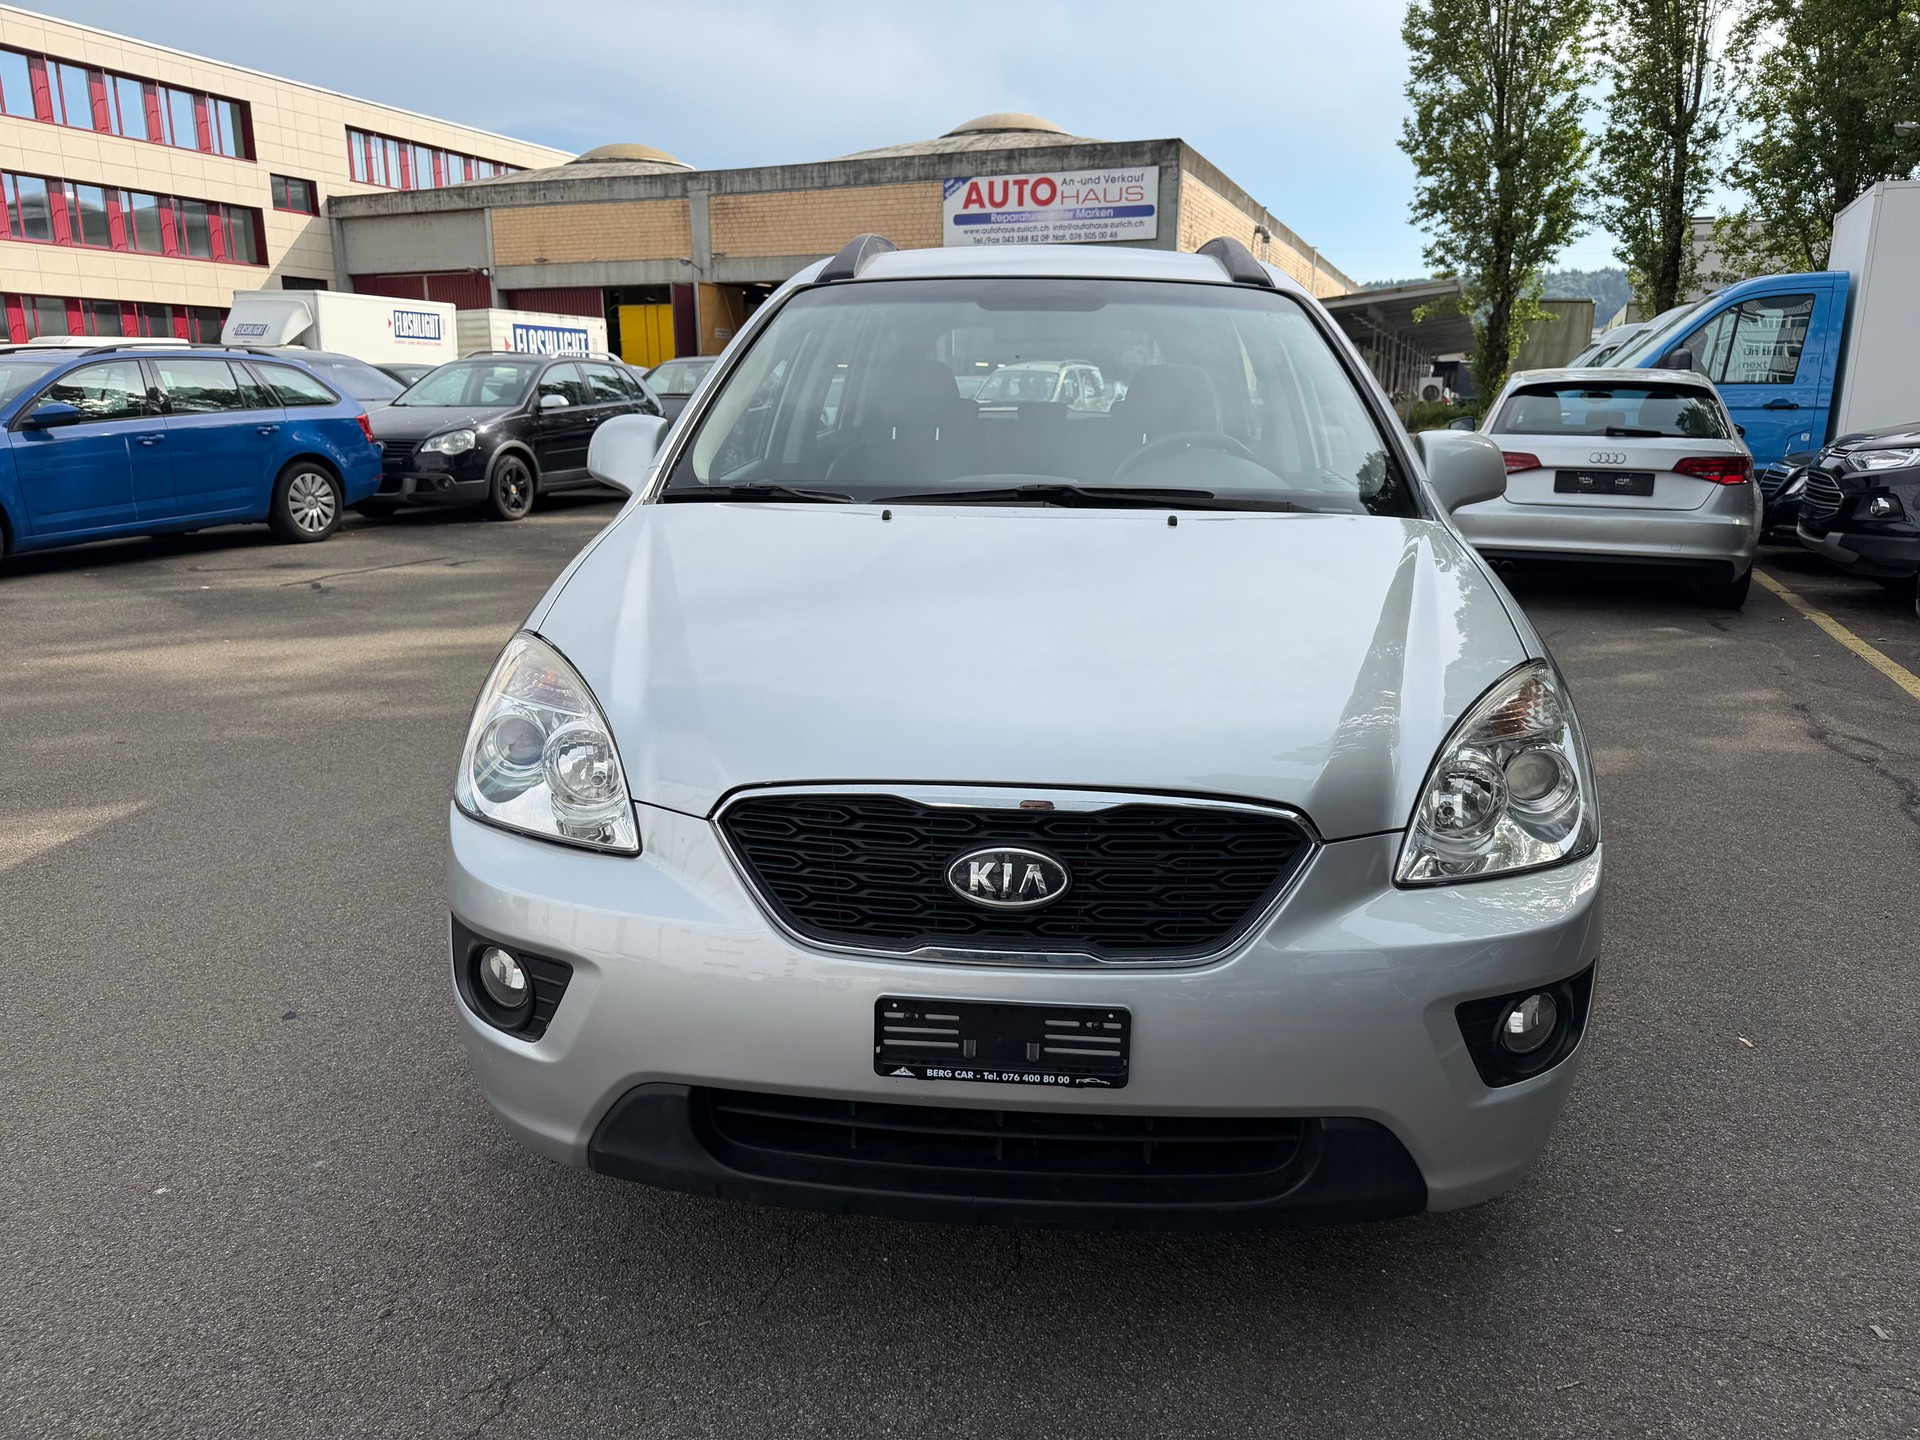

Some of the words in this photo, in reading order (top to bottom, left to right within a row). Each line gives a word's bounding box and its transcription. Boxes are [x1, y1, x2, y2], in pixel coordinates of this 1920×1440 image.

[1061, 178, 1074, 186] An
[1077, 175, 1100, 185] -und
[1103, 173, 1144, 184] Verkauf
[962, 177, 1057, 210] AUTO
[1061, 185, 1144, 205] HAUS
[990, 211, 1049, 224] Reparature
[1076, 208, 1113, 219] Marken
[1002, 235, 1015, 243] 043
[1031, 234, 1039, 242] 82
[1040, 234, 1049, 242] 09
[395, 311, 439, 338] FLASHLIGHT
[1742, 360, 1769, 369] next
[969, 861, 1048, 895] KIA
[926, 1069, 952, 1079] BERG
[954, 1070, 974, 1079] CAR
[983, 1072, 1000, 1080] Tel.
[1002, 1073, 1020, 1082] 076
[1022, 1074, 1041, 1083] 400
[1043, 1074, 1056, 1083] 80
[1057, 1075, 1070, 1084] 00
